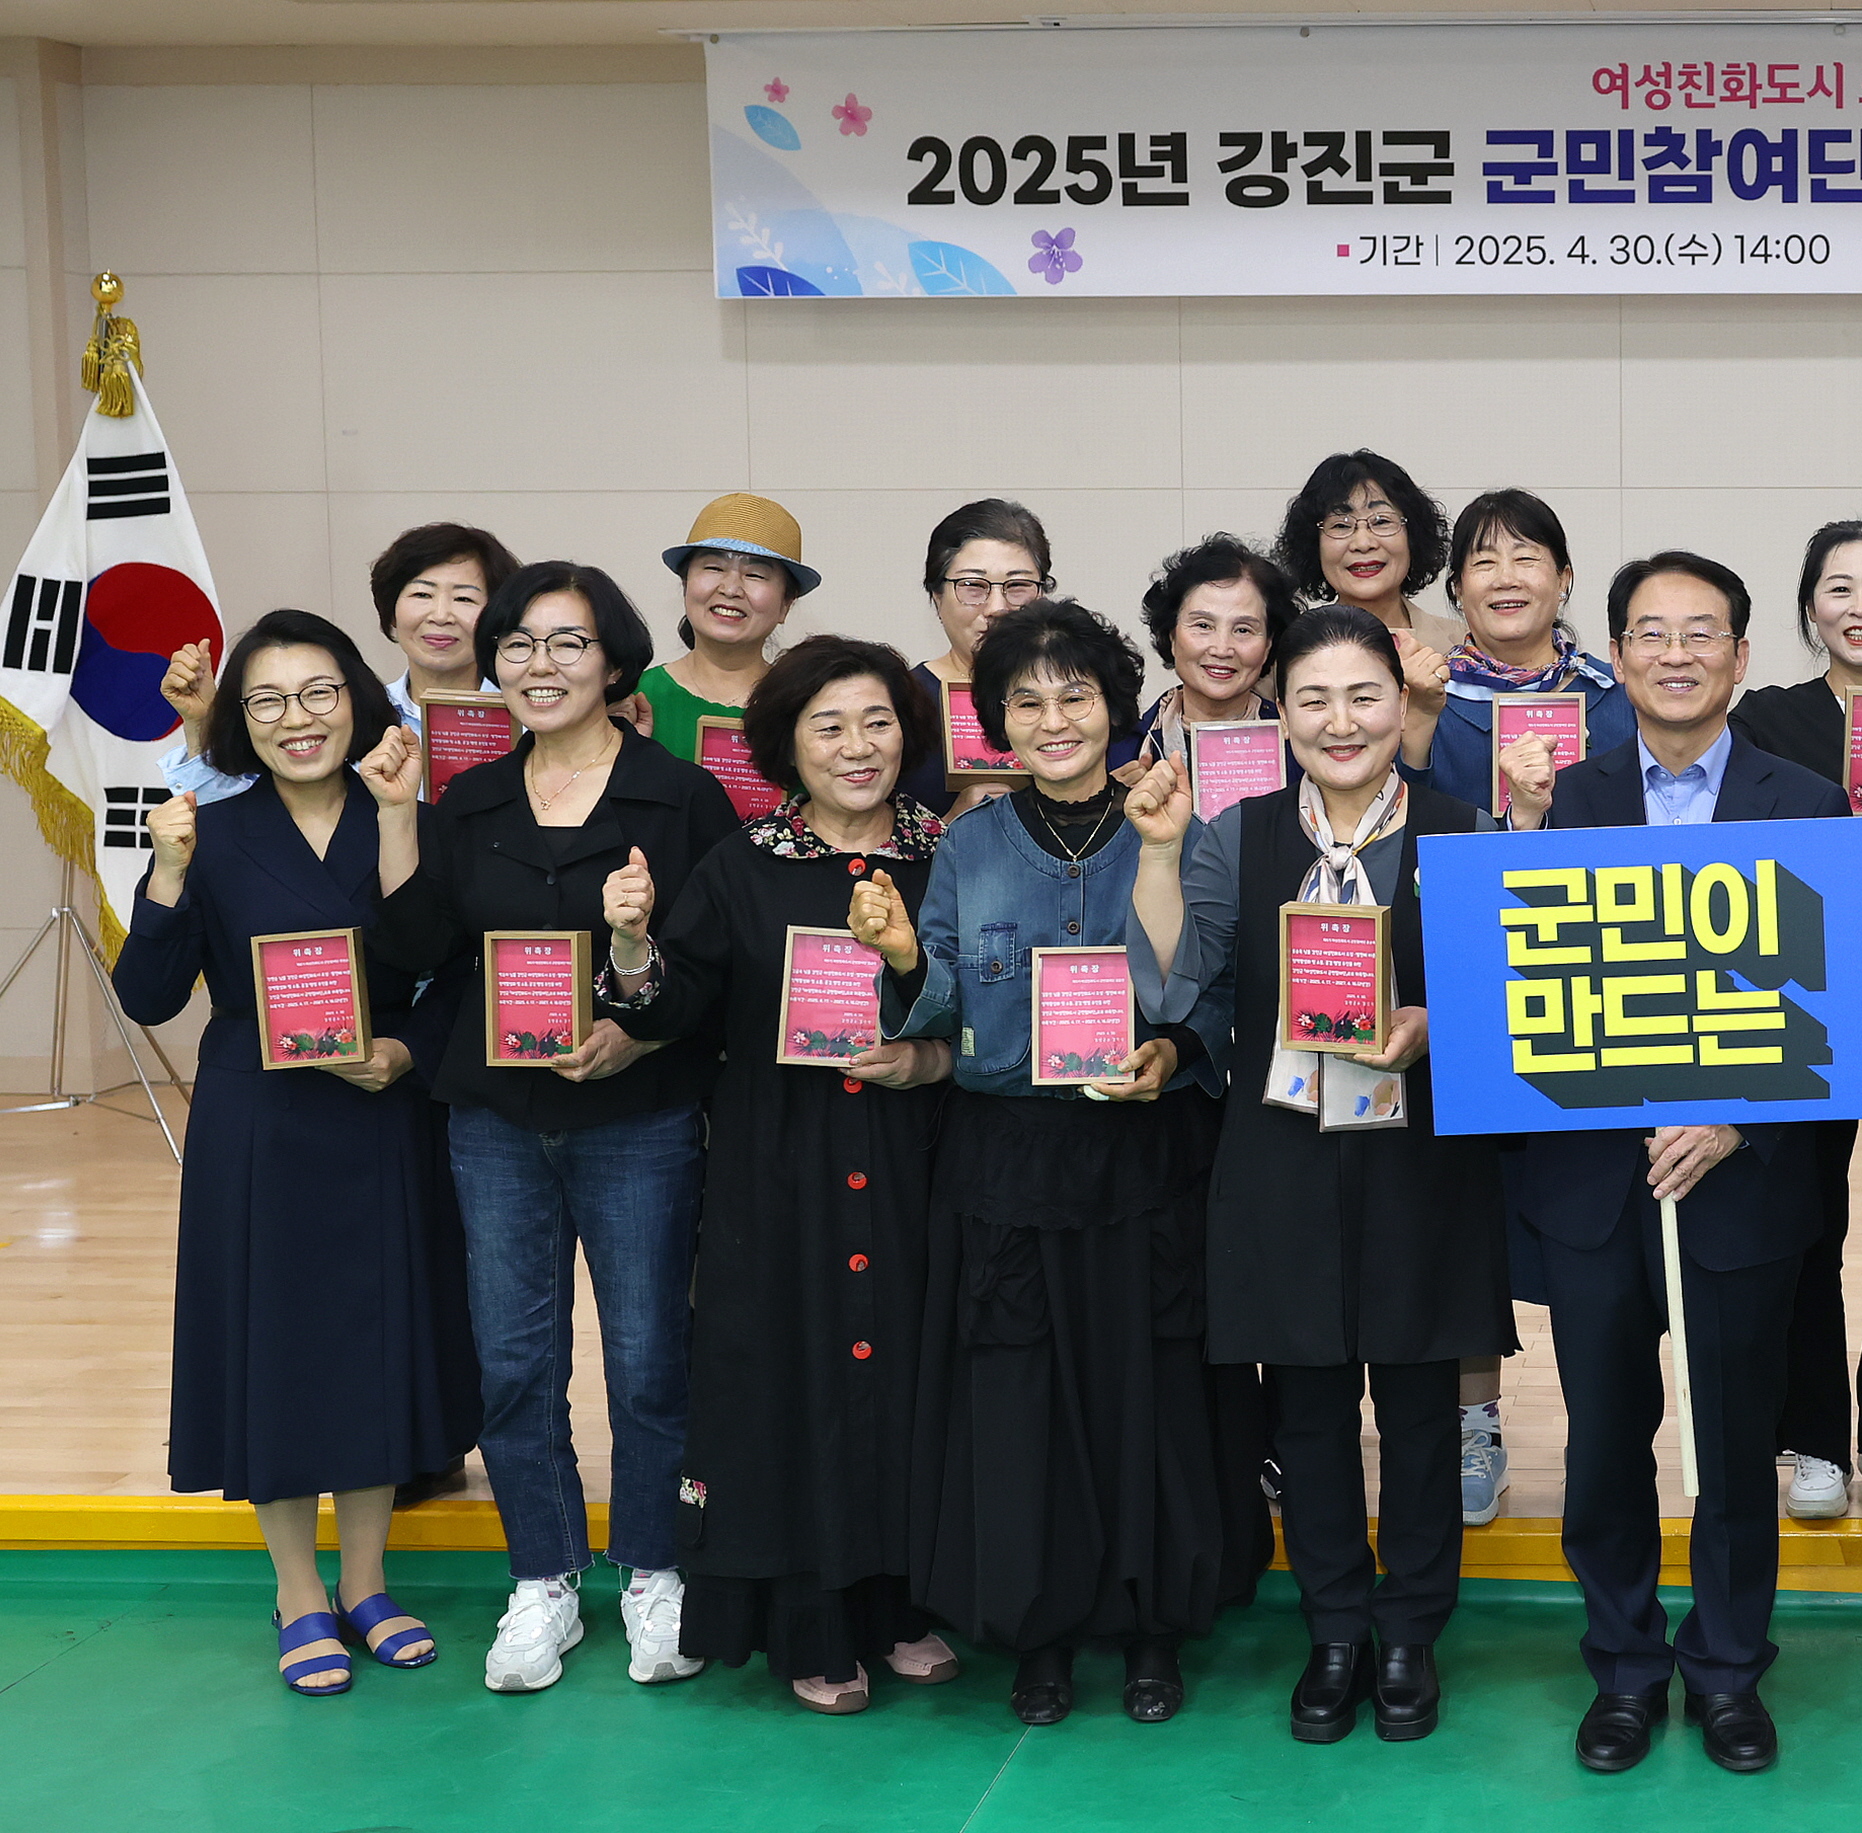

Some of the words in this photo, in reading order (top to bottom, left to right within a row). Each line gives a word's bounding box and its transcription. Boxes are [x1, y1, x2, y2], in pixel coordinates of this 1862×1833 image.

[1592, 61, 1844, 111] 여성친화도시
[906, 130, 1190, 207] 2025년
[1216, 130, 1455, 209] 강진군
[1359, 234, 1425, 267] 기간
[1454, 234, 1555, 266] 2025.
[1566, 235, 1598, 265] 4.
[1609, 232, 1723, 266] 30.(수)
[1733, 233, 1831, 265] 14:00
[1499, 859, 1780, 969] 군민이
[1506, 969, 1787, 1076] 만드는
